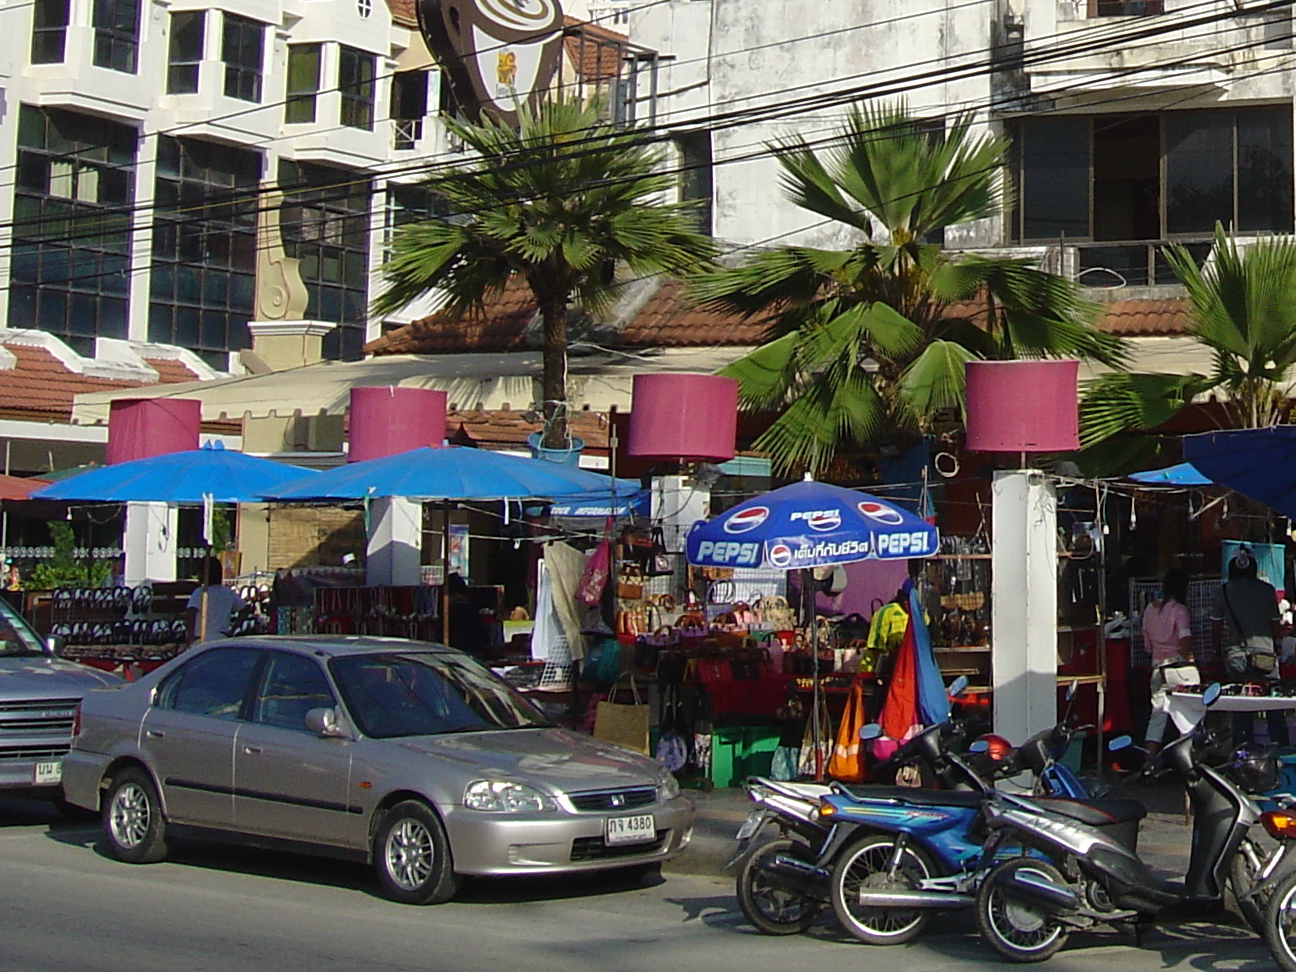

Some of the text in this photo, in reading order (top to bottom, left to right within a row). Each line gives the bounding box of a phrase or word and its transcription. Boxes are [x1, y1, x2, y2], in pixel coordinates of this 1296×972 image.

[790, 509, 840, 522] PEPSI
[878, 531, 929, 554] PEPSI
[695, 541, 760, 563] PEPSI
[627, 817, 652, 830] 4380
